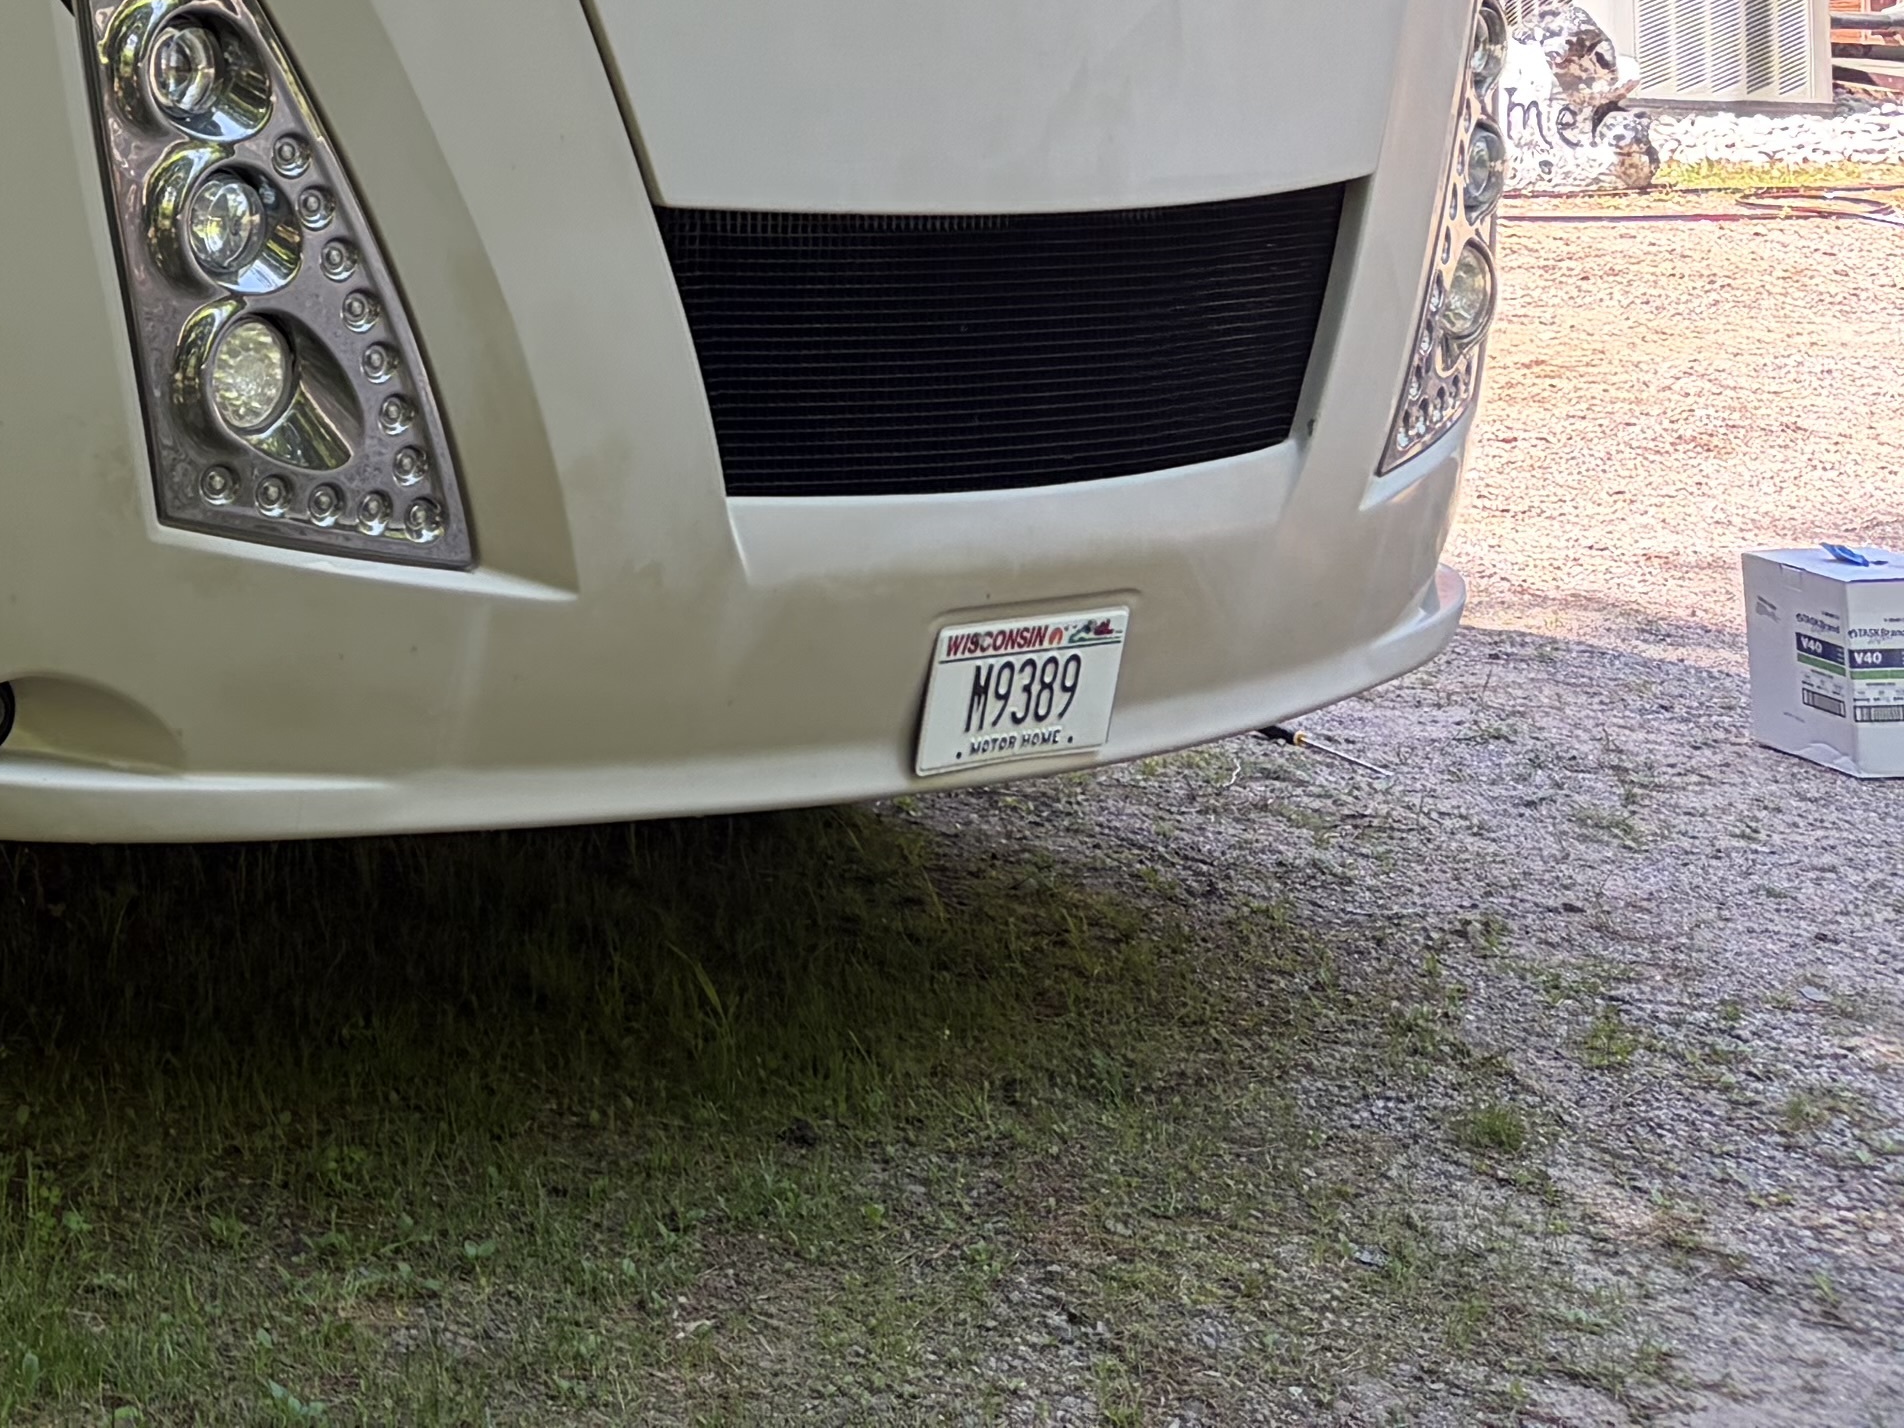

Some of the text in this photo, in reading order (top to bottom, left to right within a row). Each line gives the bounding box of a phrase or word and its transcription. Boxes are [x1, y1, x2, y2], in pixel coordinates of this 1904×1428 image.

[946, 625, 1049, 657] WISCONSIN
[1801, 635, 1823, 654] V40
[1854, 651, 1882, 665] V40
[964, 653, 1082, 733] M9389
[970, 729, 1061, 756] MOTOR HOME
